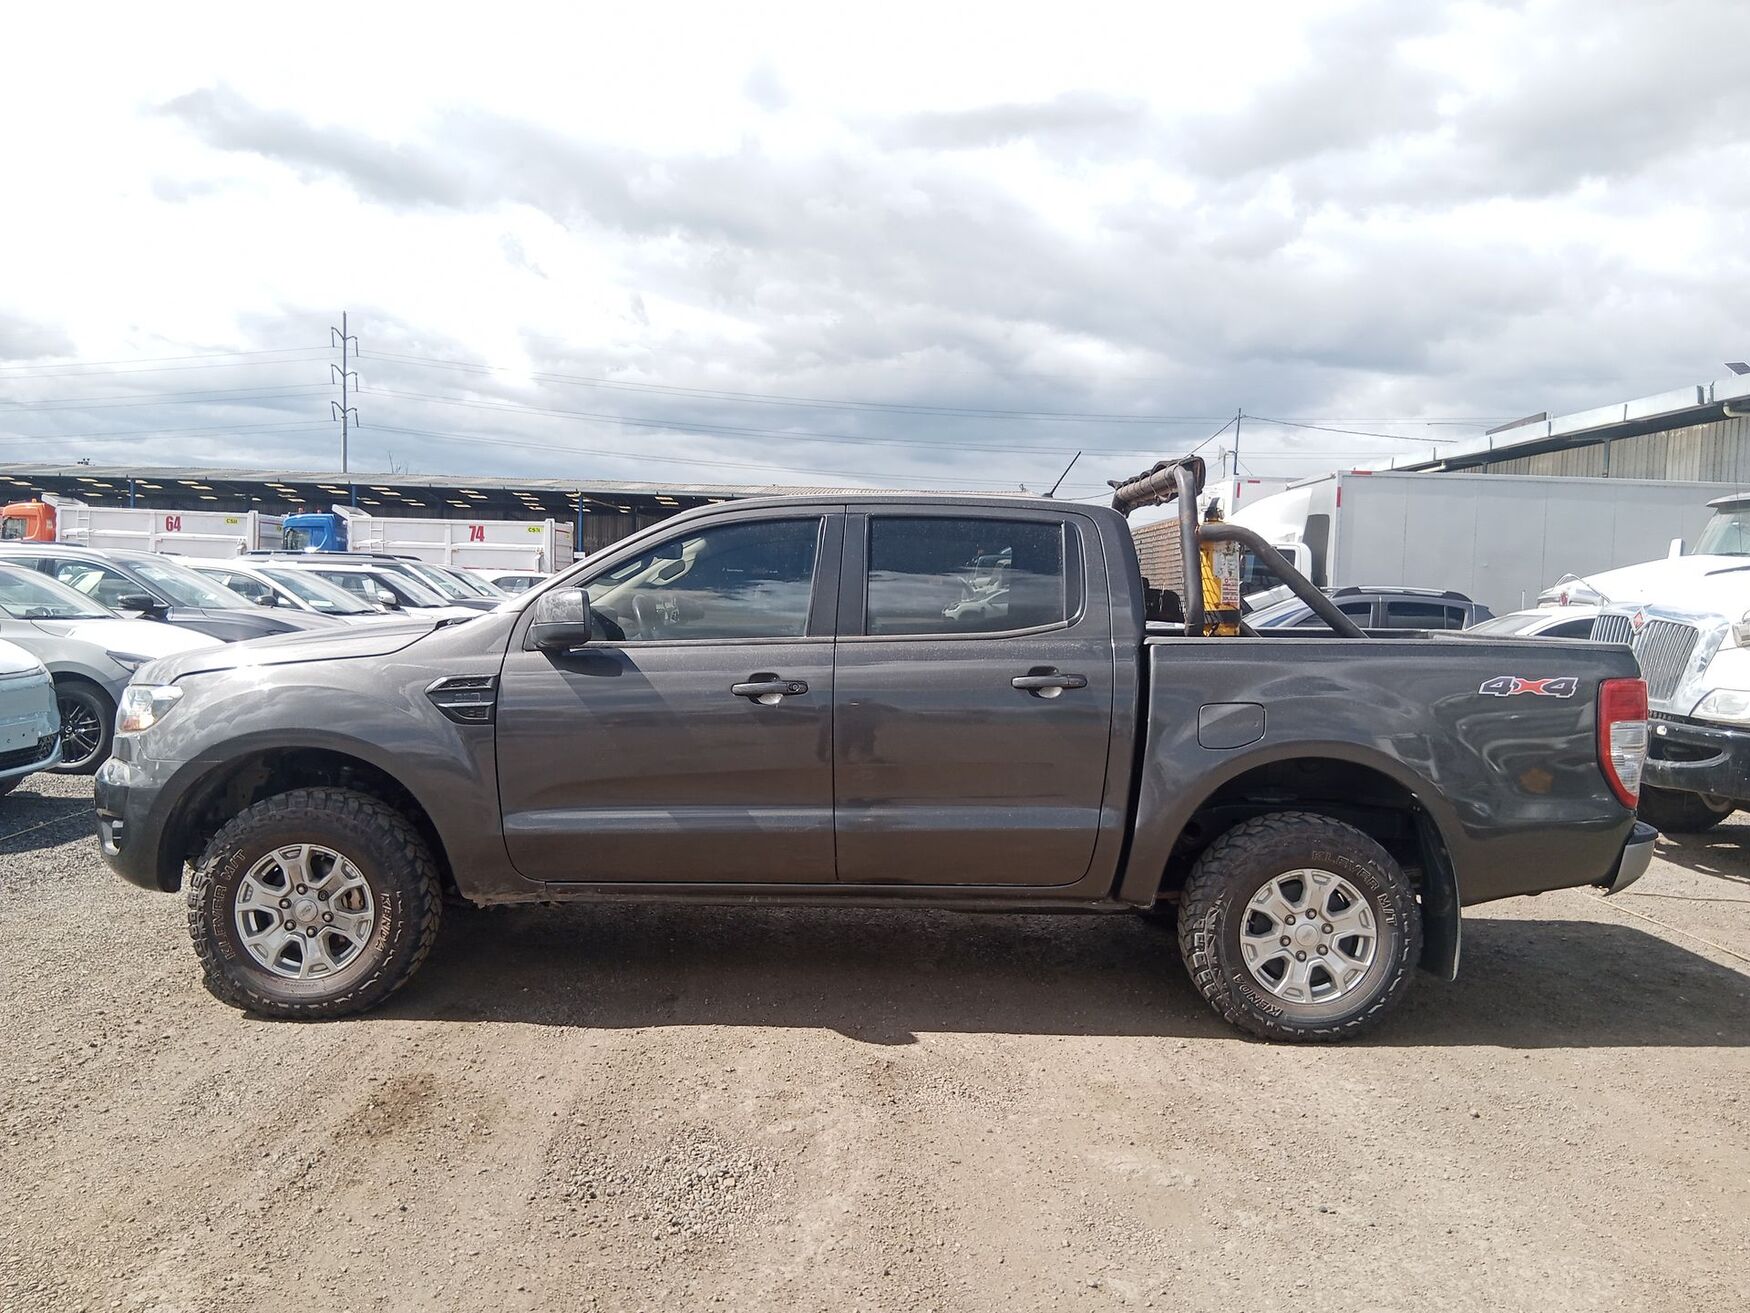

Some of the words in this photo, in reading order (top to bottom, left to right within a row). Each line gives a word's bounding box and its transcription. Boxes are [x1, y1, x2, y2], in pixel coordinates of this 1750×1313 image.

[166, 516, 182, 532] 64
[469, 525, 485, 542] 74
[220, 849, 245, 880] M/T
[1312, 851, 1379, 891] KLEVER
[1377, 893, 1398, 926] M/T
[212, 885, 236, 960] KLEVER
[375, 893, 392, 952] KENDA
[1232, 973, 1283, 1017] KENDA
